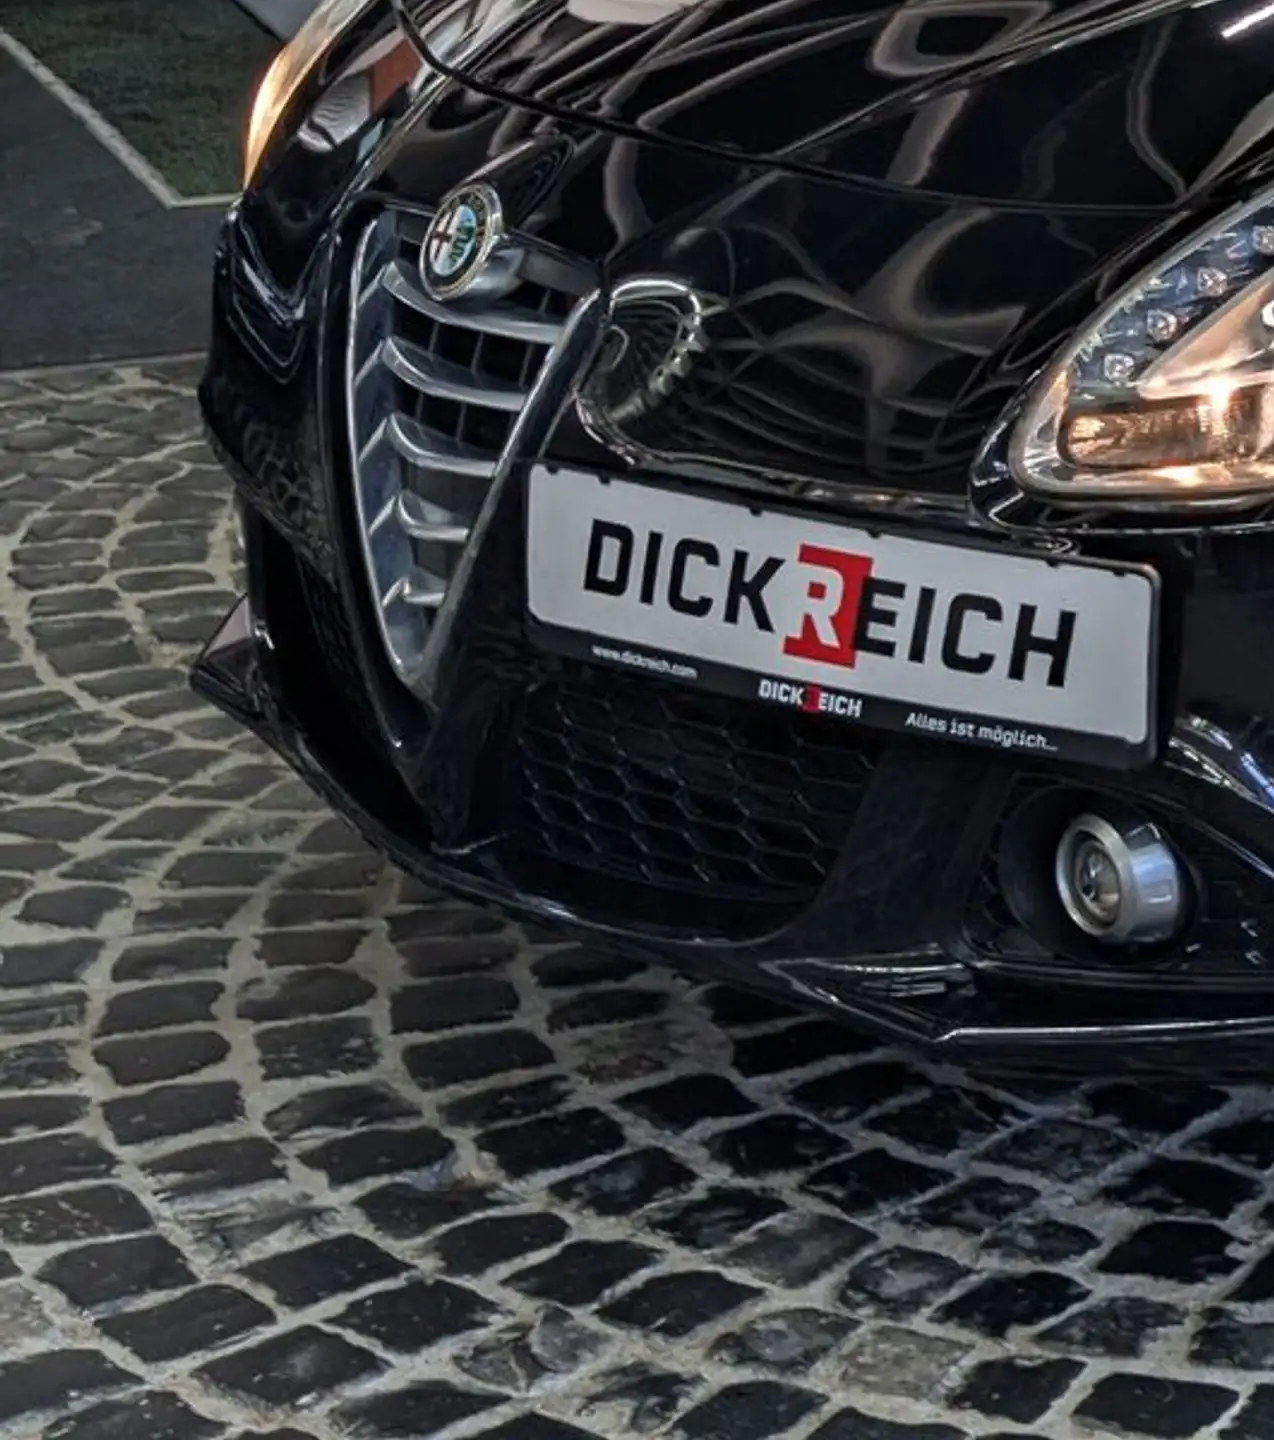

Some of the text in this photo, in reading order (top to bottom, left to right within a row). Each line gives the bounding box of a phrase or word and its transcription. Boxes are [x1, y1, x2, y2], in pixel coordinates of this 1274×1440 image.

[583, 518, 1077, 687] DICKREICH
[905, 711, 947, 733] Alles
[950, 718, 976, 738] ist
